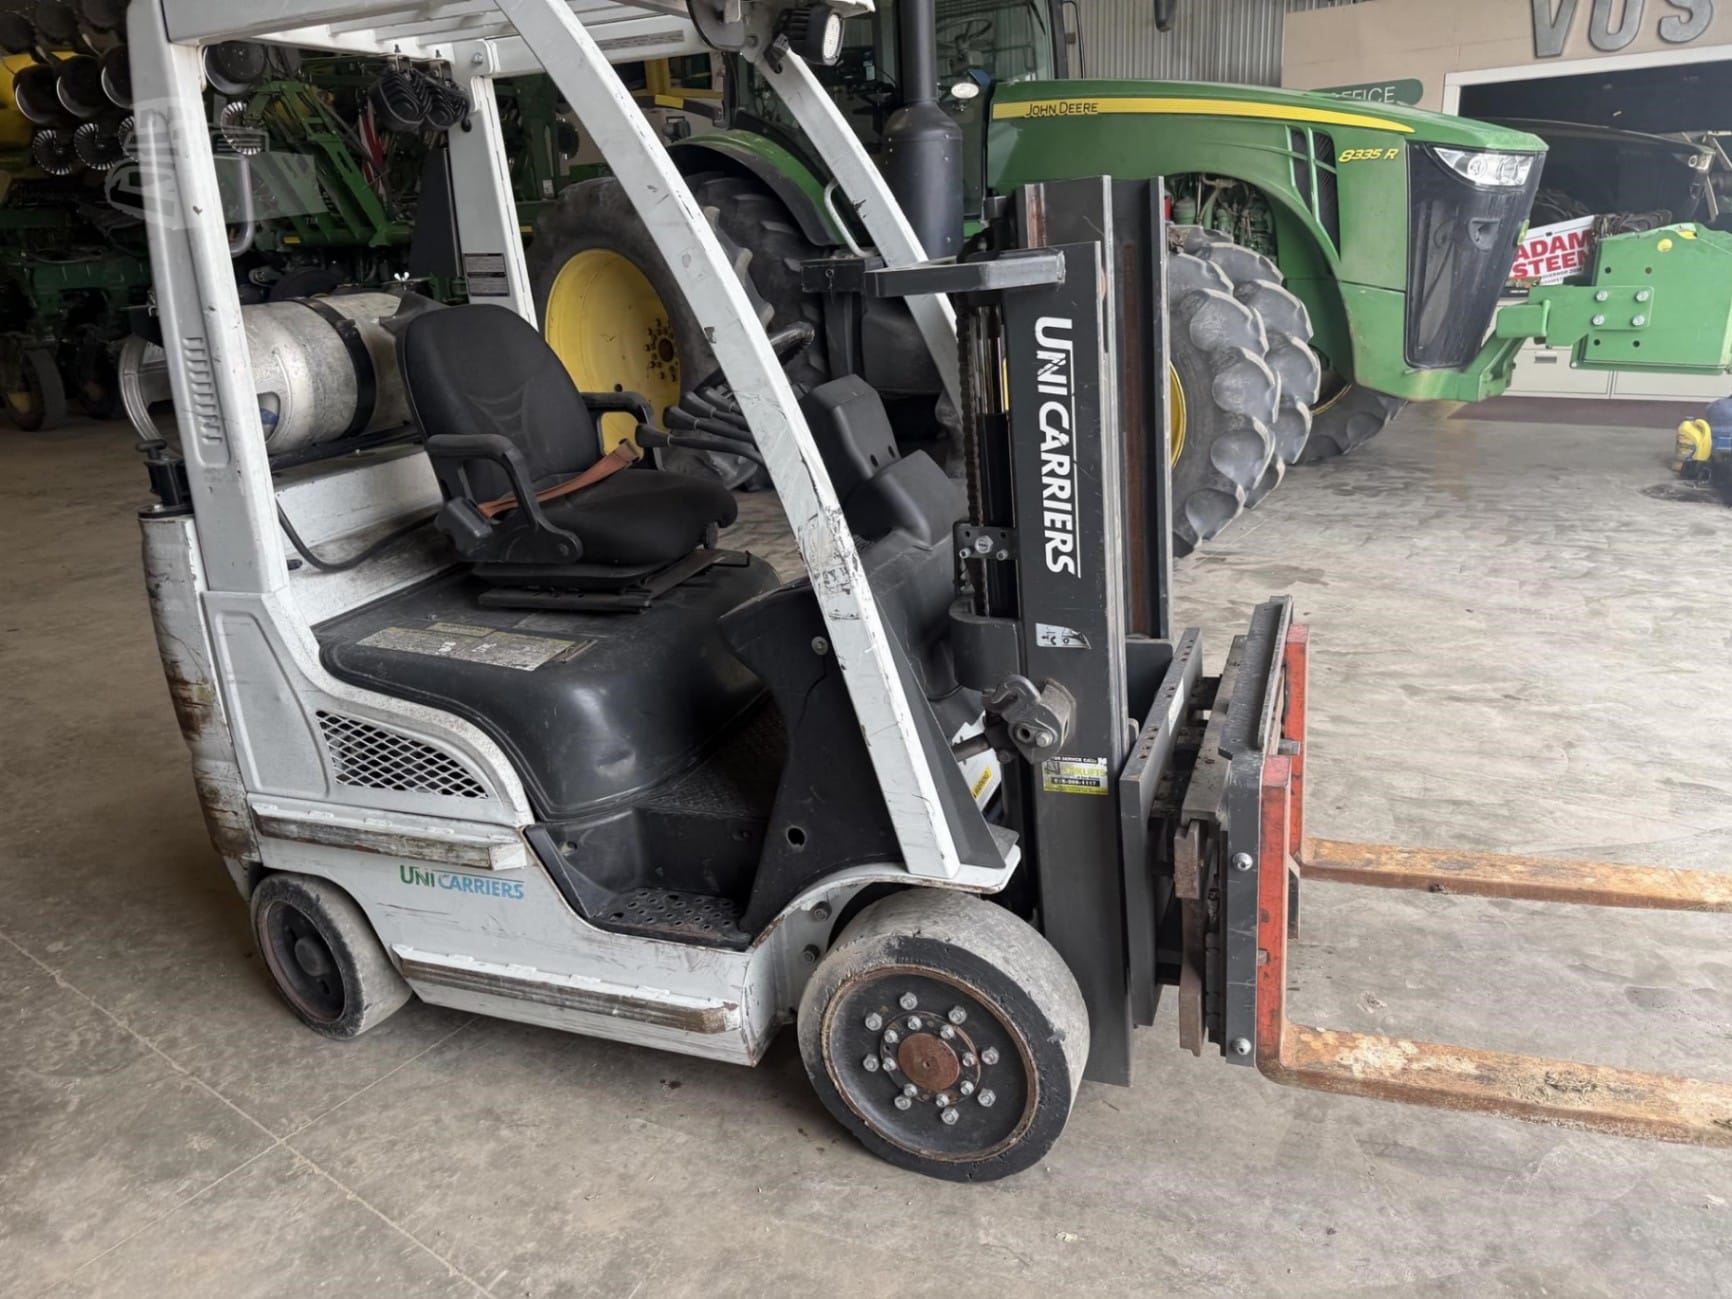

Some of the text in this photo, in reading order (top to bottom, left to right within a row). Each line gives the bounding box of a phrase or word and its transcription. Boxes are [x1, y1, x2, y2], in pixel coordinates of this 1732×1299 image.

[1331, 86, 1396, 104] FICE
[1025, 101, 1099, 117] JOHN DEERE
[1338, 148, 1399, 163] 8335 R
[1514, 228, 1593, 261] ADAM
